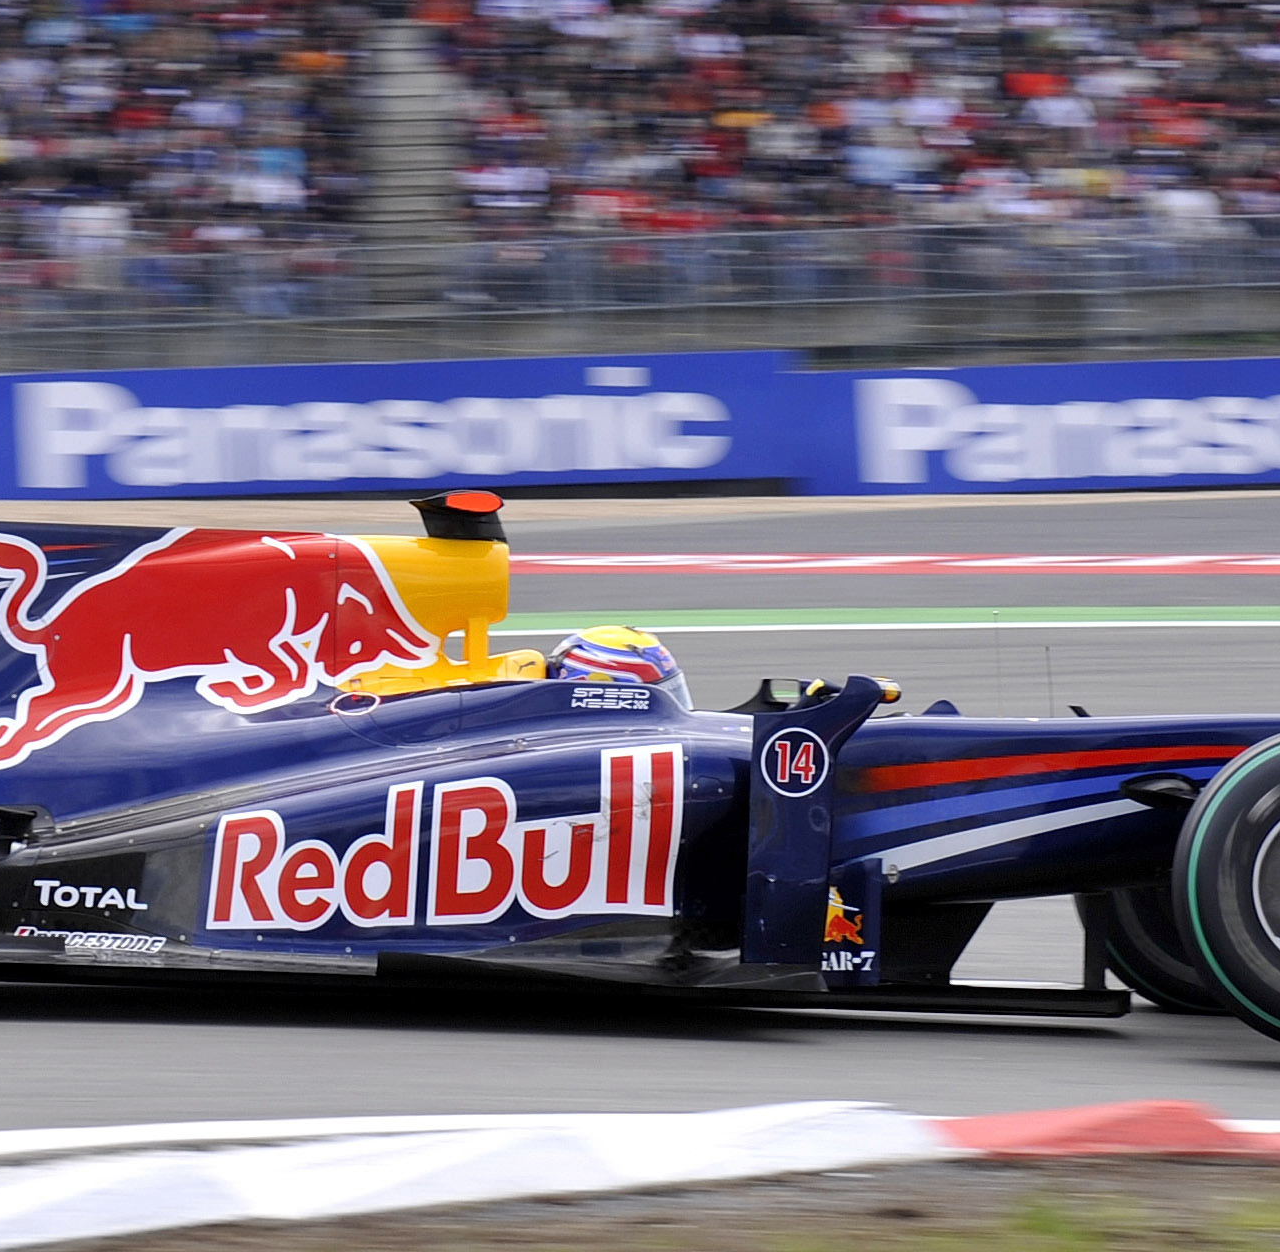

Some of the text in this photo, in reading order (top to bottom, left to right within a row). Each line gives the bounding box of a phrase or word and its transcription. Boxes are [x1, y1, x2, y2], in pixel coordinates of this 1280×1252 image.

[14, 366, 733, 488] Panasonic
[571, 698, 635, 709] WEEK
[572, 687, 650, 698] SPEED
[775, 741, 815, 783] 14
[207, 743, 683, 930] Red Bull
